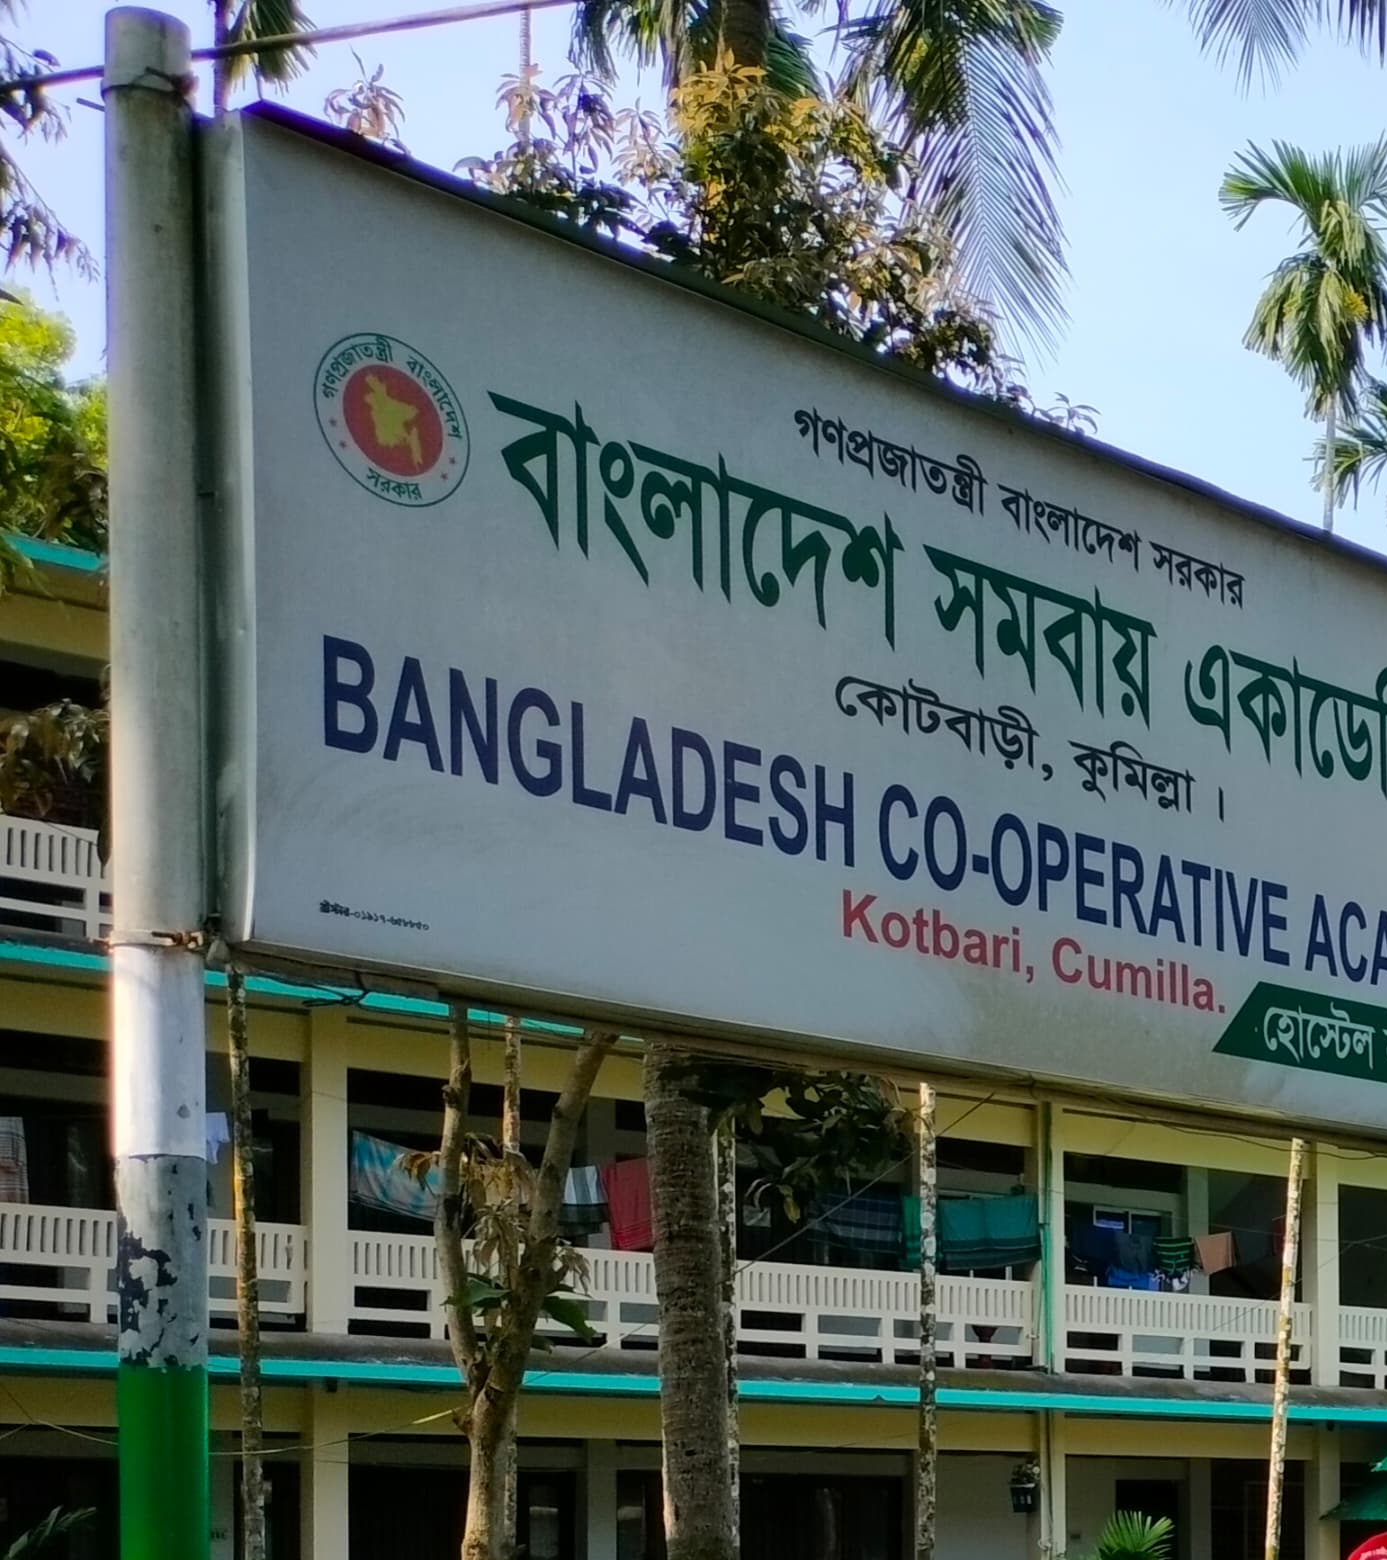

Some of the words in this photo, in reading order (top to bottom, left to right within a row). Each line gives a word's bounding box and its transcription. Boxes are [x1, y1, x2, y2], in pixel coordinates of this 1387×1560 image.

[406, 355, 462, 440] বাংলাদেশ
[366, 466, 422, 500] সরকার
[794, 406, 987, 516] গণপ্রজাতন্ত্রী
[998, 483, 1140, 570] বাংলাদেশ
[1152, 541, 1245, 608] সরকার
[487, 390, 904, 651] বাংলাদেশ
[924, 544, 1156, 729] সমবায়
[323, 634, 855, 868] BANGLADESH
[878, 783, 1289, 967] CO-OPERATIVE
[1070, 738, 1195, 814] কুমিল্লা
[841, 889, 1035, 984] Kotbari,
[1052, 936, 1226, 1014] Cumilla.
[1262, 1003, 1376, 1071] হোস্টেল
